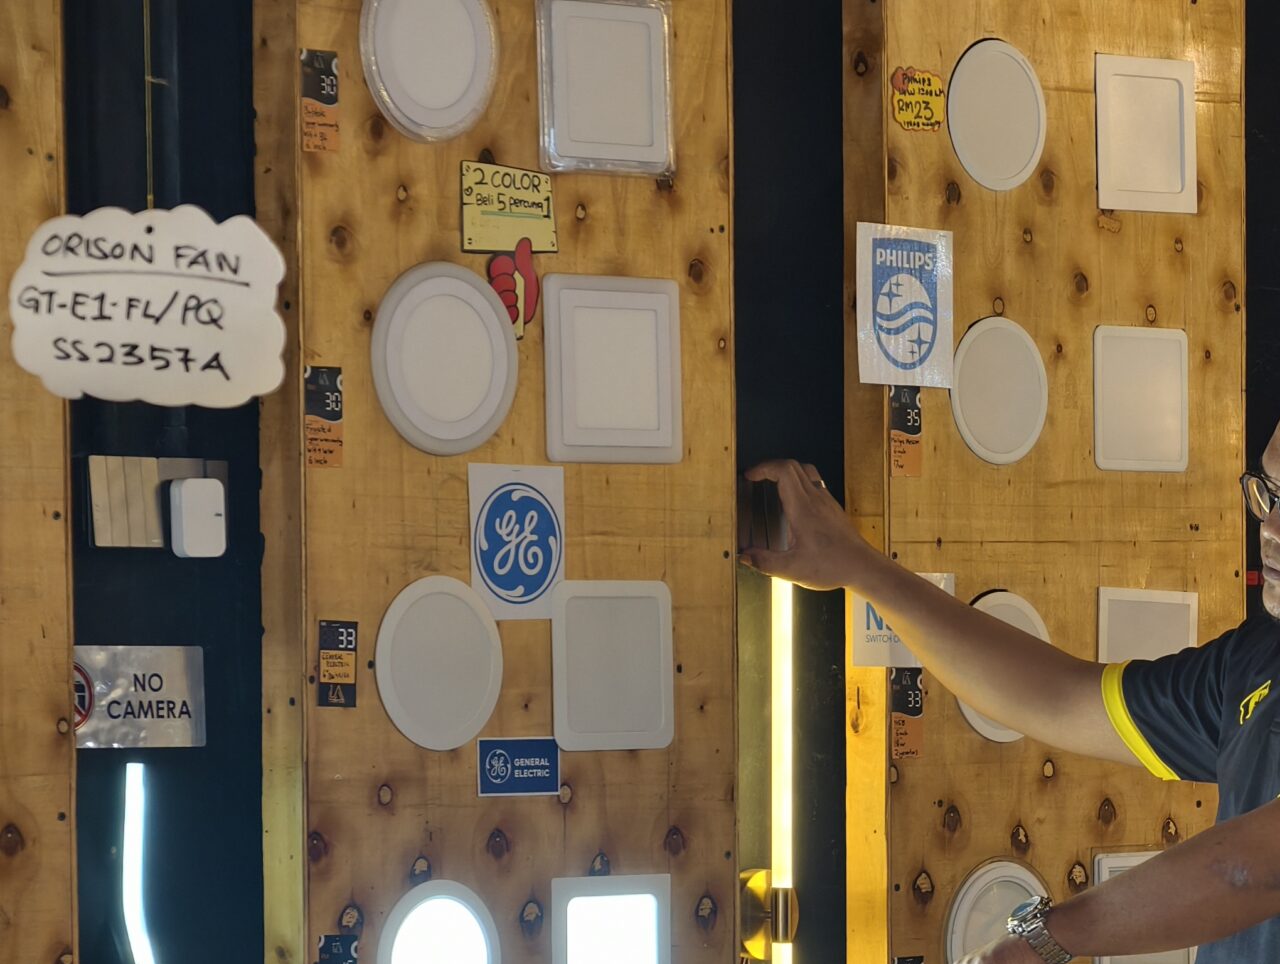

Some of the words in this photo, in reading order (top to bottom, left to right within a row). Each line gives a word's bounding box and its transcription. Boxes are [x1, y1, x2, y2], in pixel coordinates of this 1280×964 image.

[320, 75, 337, 95] 30
[473, 168, 488, 185] 2
[491, 171, 541, 193] COLOR
[475, 193, 494, 206] Beli
[497, 193, 507, 211] 5
[543, 196, 551, 218] 1
[41, 233, 153, 263] ORISON
[174, 246, 240, 275] FAN
[876, 248, 934, 270] PHILIPS
[53, 338, 230, 381] SS2357A
[324, 391, 341, 411] 30
[906, 409, 920, 426] 35
[338, 628, 356, 649] 33
[132, 672, 163, 692] NO
[908, 690, 921, 707] 33
[106, 700, 192, 719] CAMERA
[514, 758, 549, 767] GENERAL
[514, 769, 550, 778] ELECTRIC
